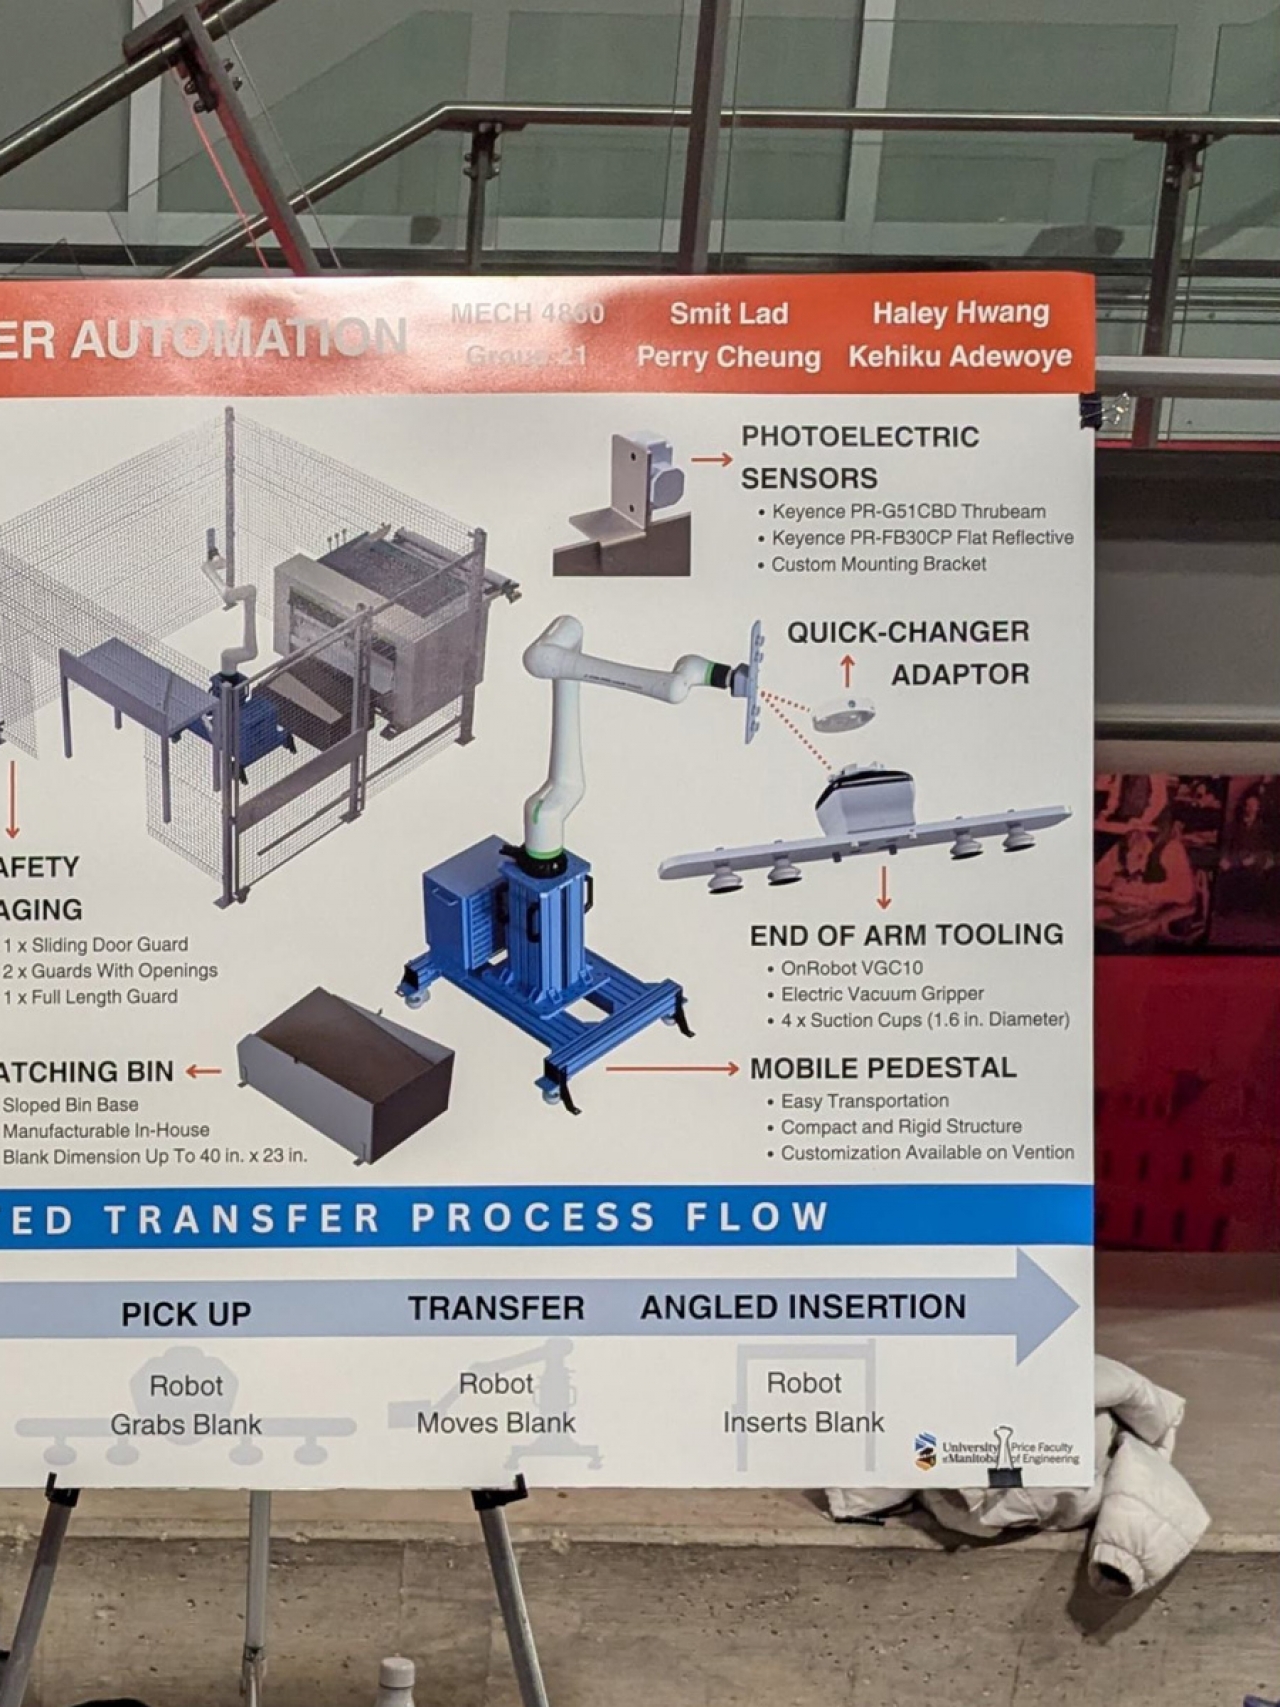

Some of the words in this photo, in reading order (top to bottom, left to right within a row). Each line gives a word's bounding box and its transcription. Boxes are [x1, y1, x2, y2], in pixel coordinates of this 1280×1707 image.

[451, 303, 531, 324] MECH
[671, 302, 731, 324] Smit
[740, 302, 788, 324] Lad
[874, 301, 948, 330] Haley
[957, 300, 1049, 327] Hwang
[72, 316, 407, 359] AUTOMATION
[636, 345, 708, 372] Perry
[717, 345, 820, 373] Cheung
[850, 345, 940, 367] Kehiku
[950, 345, 1072, 372] Adewoye
[743, 425, 979, 447] PHOTOELECTRIC
[742, 468, 877, 489] SENSORS
[774, 504, 845, 522] Keyence
[852, 503, 956, 518] PR-G51CBD
[961, 504, 1046, 519] Thrubeam
[773, 530, 845, 549] Keyence
[851, 529, 952, 545] PR-FB30CP
[957, 530, 987, 545] Flat
[993, 530, 1074, 545] Reflective
[772, 556, 836, 572] Custom
[842, 556, 918, 575] Mounting
[924, 556, 986, 571] Bracket
[788, 620, 1029, 643] QUICK-CHANGER
[892, 663, 1029, 685] ADAPTOR
[751, 926, 808, 946] END
[818, 925, 855, 946] OF
[864, 925, 926, 946] ARM
[936, 923, 1063, 945] TOOLING
[3, 964, 13, 979] 2
[18, 967, 27, 978] x
[32, 963, 91, 978] Guards
[97, 963, 133, 978] With
[138, 963, 218, 981] Openings
[782, 960, 857, 976] OnRobot
[862, 960, 923, 975] VGC10
[782, 987, 842, 1001] Electric
[848, 987, 916, 1001] Vacuum
[922, 986, 984, 1004] Gripper
[782, 1013, 791, 1027] 4
[797, 1016, 805, 1027] x
[811, 1012, 872, 1027] Suction
[878, 1012, 922, 1030] Cups
[928, 1012, 959, 1030] (1.6
[964, 1012, 983, 1026] in.
[990, 1011, 1069, 1030] Diameter)
[128, 1061, 172, 1081] BIN
[752, 1057, 858, 1079] MOBILE
[869, 1057, 1017, 1078] PEDESTAL
[3, 1097, 60, 1115] Sloped
[66, 1097, 91, 1112] Bin
[98, 1097, 138, 1112] Base
[782, 1094, 822, 1112] Easy
[827, 1093, 949, 1111] Transportation
[4, 1123, 130, 1138] Manufacturable
[135, 1122, 209, 1137] In-House
[782, 1119, 857, 1138] Compact
[862, 1119, 893, 1134] and
[899, 1119, 941, 1137] Rigid
[947, 1118, 1022, 1134] Structure
[4, 1149, 49, 1164] Blank
[54, 1149, 140, 1164] Dimension
[146, 1148, 169, 1167] Up
[174, 1148, 195, 1163] To
[200, 1148, 220, 1163] 40
[226, 1148, 243, 1162] in.
[249, 1152, 258, 1162] x
[263, 1148, 283, 1162] 23
[289, 1148, 307, 1162] in.
[782, 1145, 900, 1161] Customization
[906, 1145, 981, 1159] Available
[987, 1148, 1007, 1159] on
[1012, 1144, 1074, 1159] Vention
[104, 1204, 377, 1233] TRANSFER
[413, 1202, 653, 1232] PROCESS
[688, 1202, 826, 1231] FLOW
[123, 1302, 197, 1326] PICK
[209, 1302, 251, 1326] UP
[408, 1296, 583, 1320] TRANSFER
[641, 1295, 777, 1319] ANGLED
[790, 1294, 965, 1319] INSERTION
[151, 1375, 223, 1396] Robot
[460, 1373, 533, 1394] Robot
[768, 1372, 841, 1393] Robot
[111, 1414, 185, 1435] Grabs
[194, 1414, 262, 1435] Blank
[418, 1412, 498, 1433] Moves
[508, 1411, 576, 1433] Blank
[725, 1411, 807, 1433] Inserts
[816, 1411, 884, 1433] Blank
[942, 1443, 1000, 1453] University
[1012, 1442, 1035, 1453] Price
[1039, 1442, 1073, 1453] Faculty
[1023, 1454, 1079, 1465] Engineering
